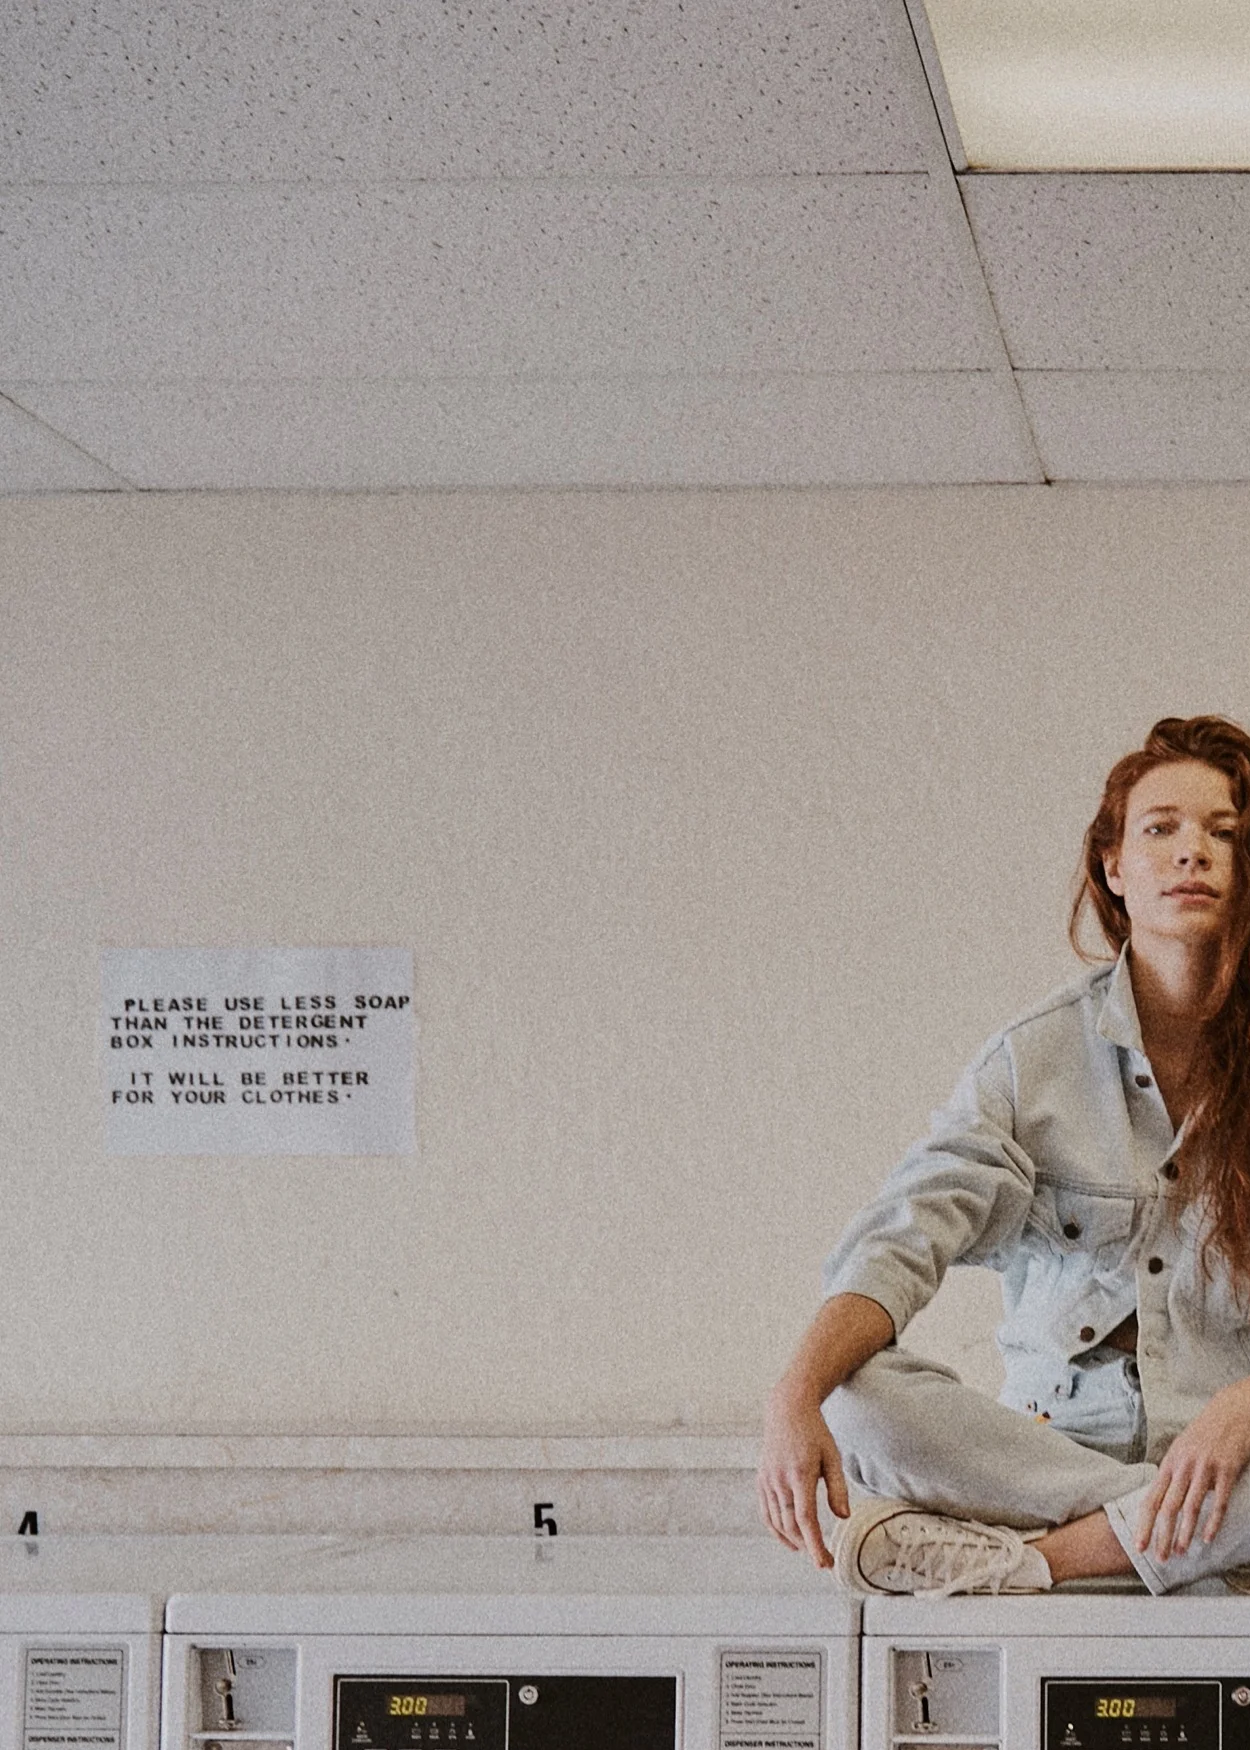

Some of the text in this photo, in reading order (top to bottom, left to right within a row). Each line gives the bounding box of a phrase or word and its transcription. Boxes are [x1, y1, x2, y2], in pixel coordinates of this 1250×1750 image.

[125, 995, 409, 1012] PLEASE USE LESS SOAP
[112, 1015, 367, 1030] THAN THE DETERGENT
[111, 1035, 152, 1049] BOX
[132, 1072, 368, 1086] IT WILL BE BETTER
[112, 1091, 153, 1103] FOR
[172, 1091, 225, 1104] YOUR
[534, 1503, 557, 1536] 5
